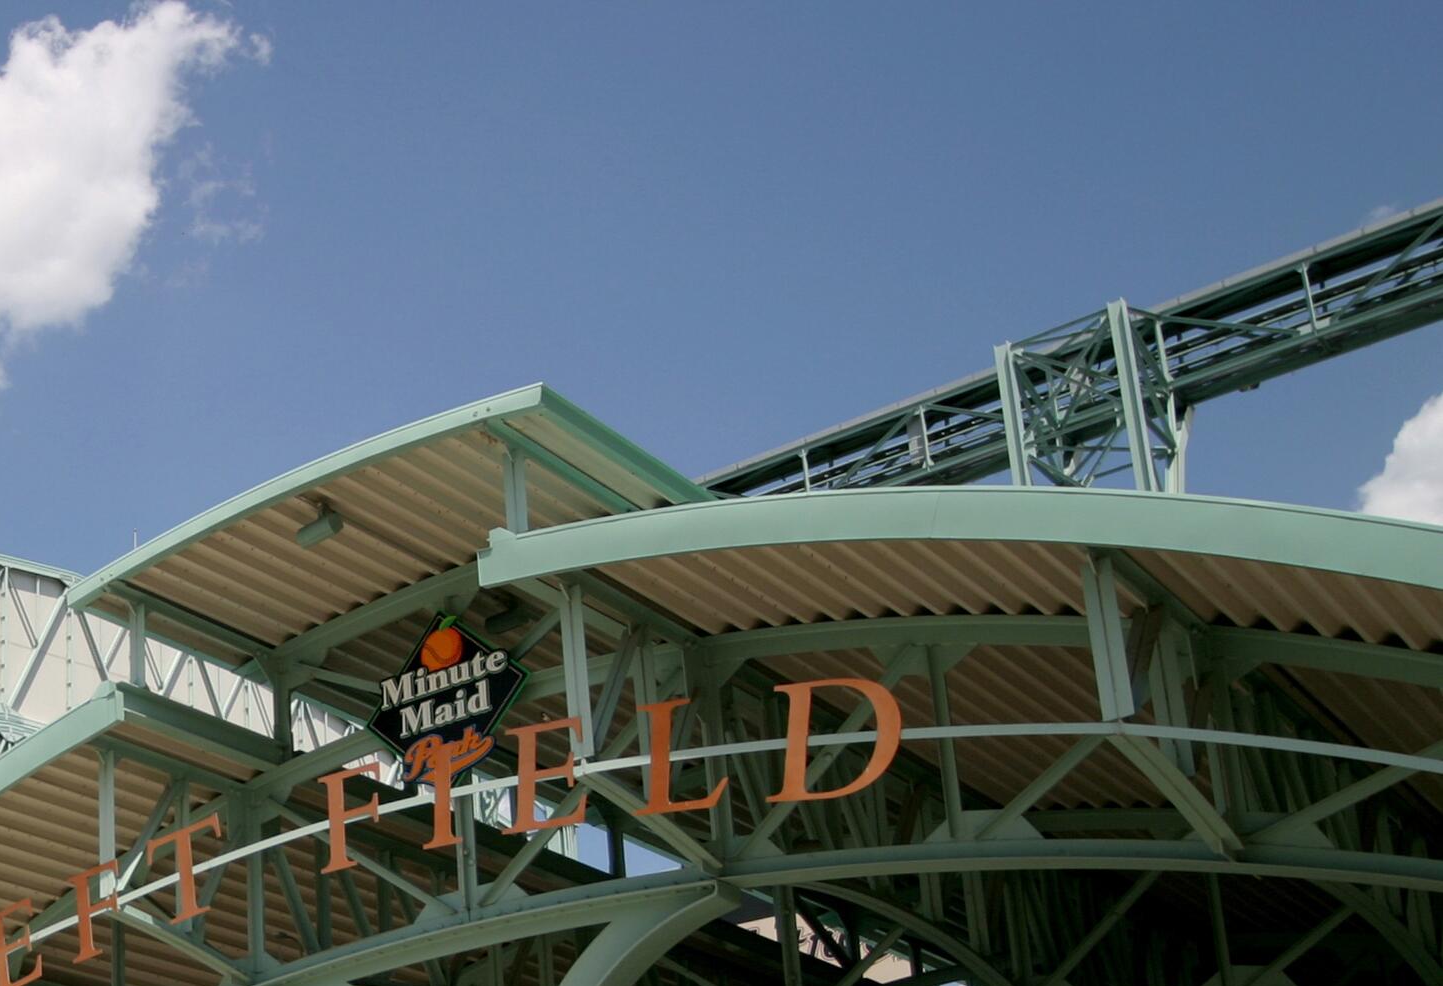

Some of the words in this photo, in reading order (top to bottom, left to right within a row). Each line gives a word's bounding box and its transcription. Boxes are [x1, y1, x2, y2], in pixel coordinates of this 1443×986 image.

[381, 650, 507, 710] Minute
[399, 678, 493, 738] Maid
[318, 677, 902, 874] FIELD
